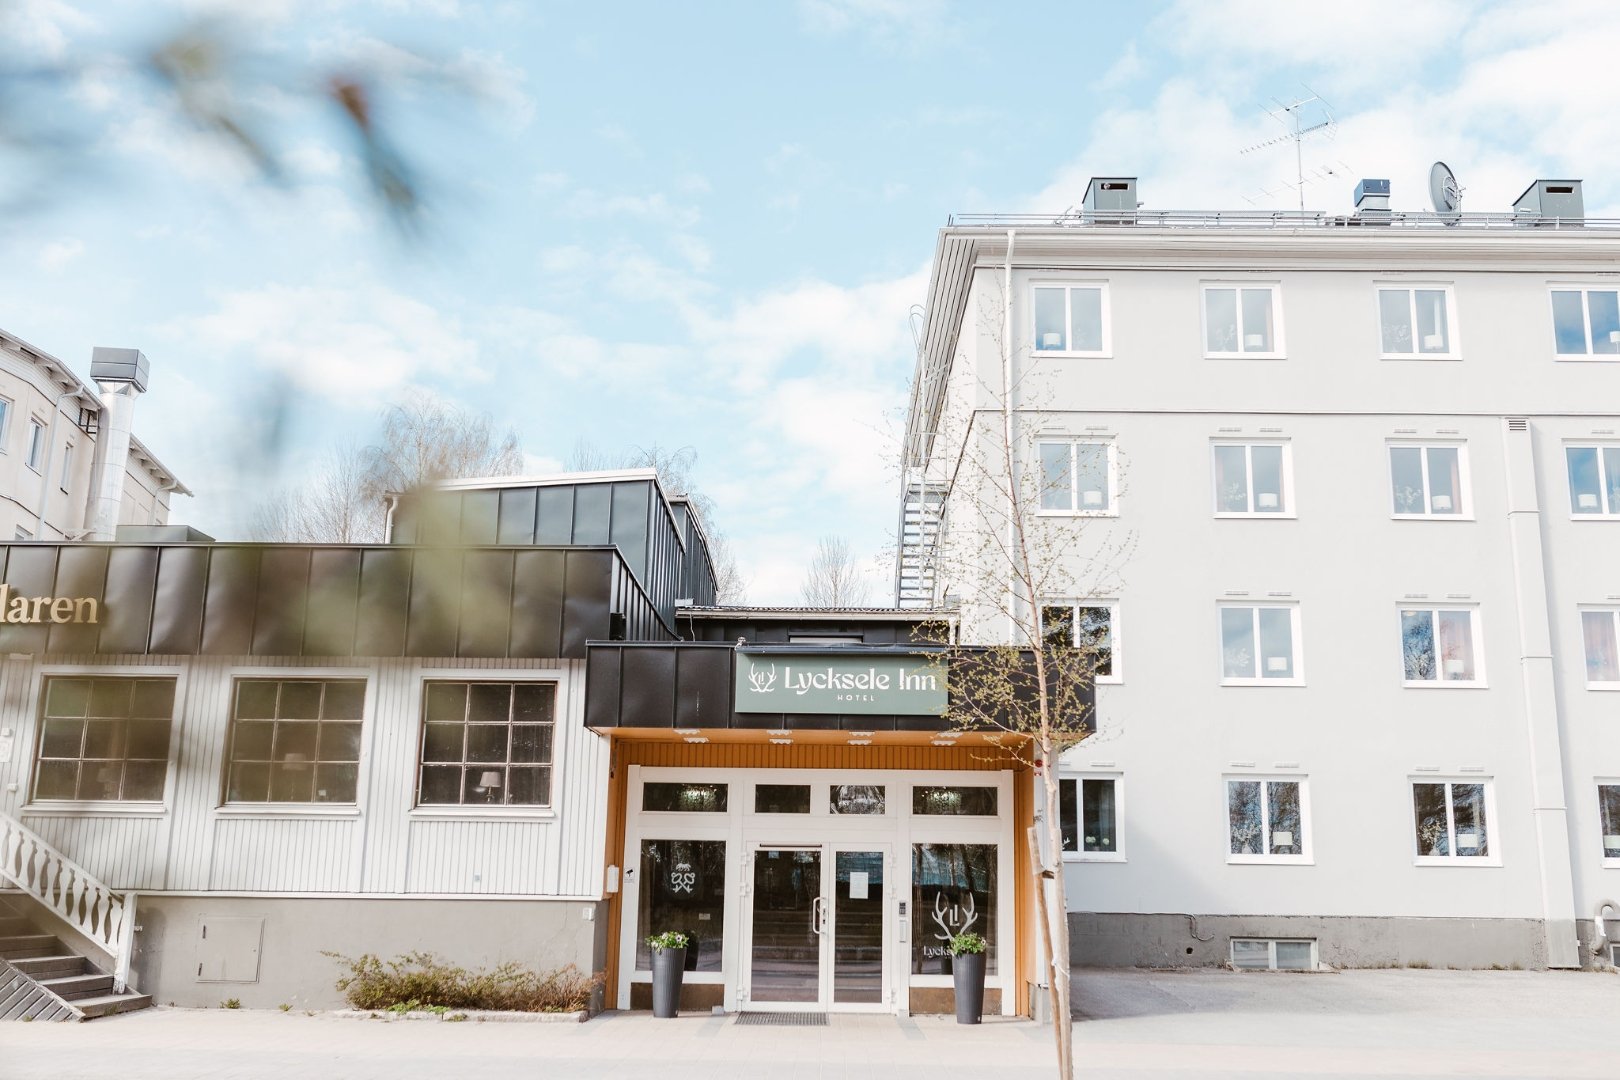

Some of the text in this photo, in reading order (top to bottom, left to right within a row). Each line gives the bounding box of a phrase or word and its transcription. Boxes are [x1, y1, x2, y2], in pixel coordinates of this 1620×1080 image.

[784, 666, 936, 695] Lycksele Inn
[837, 694, 875, 702] HOTEL
